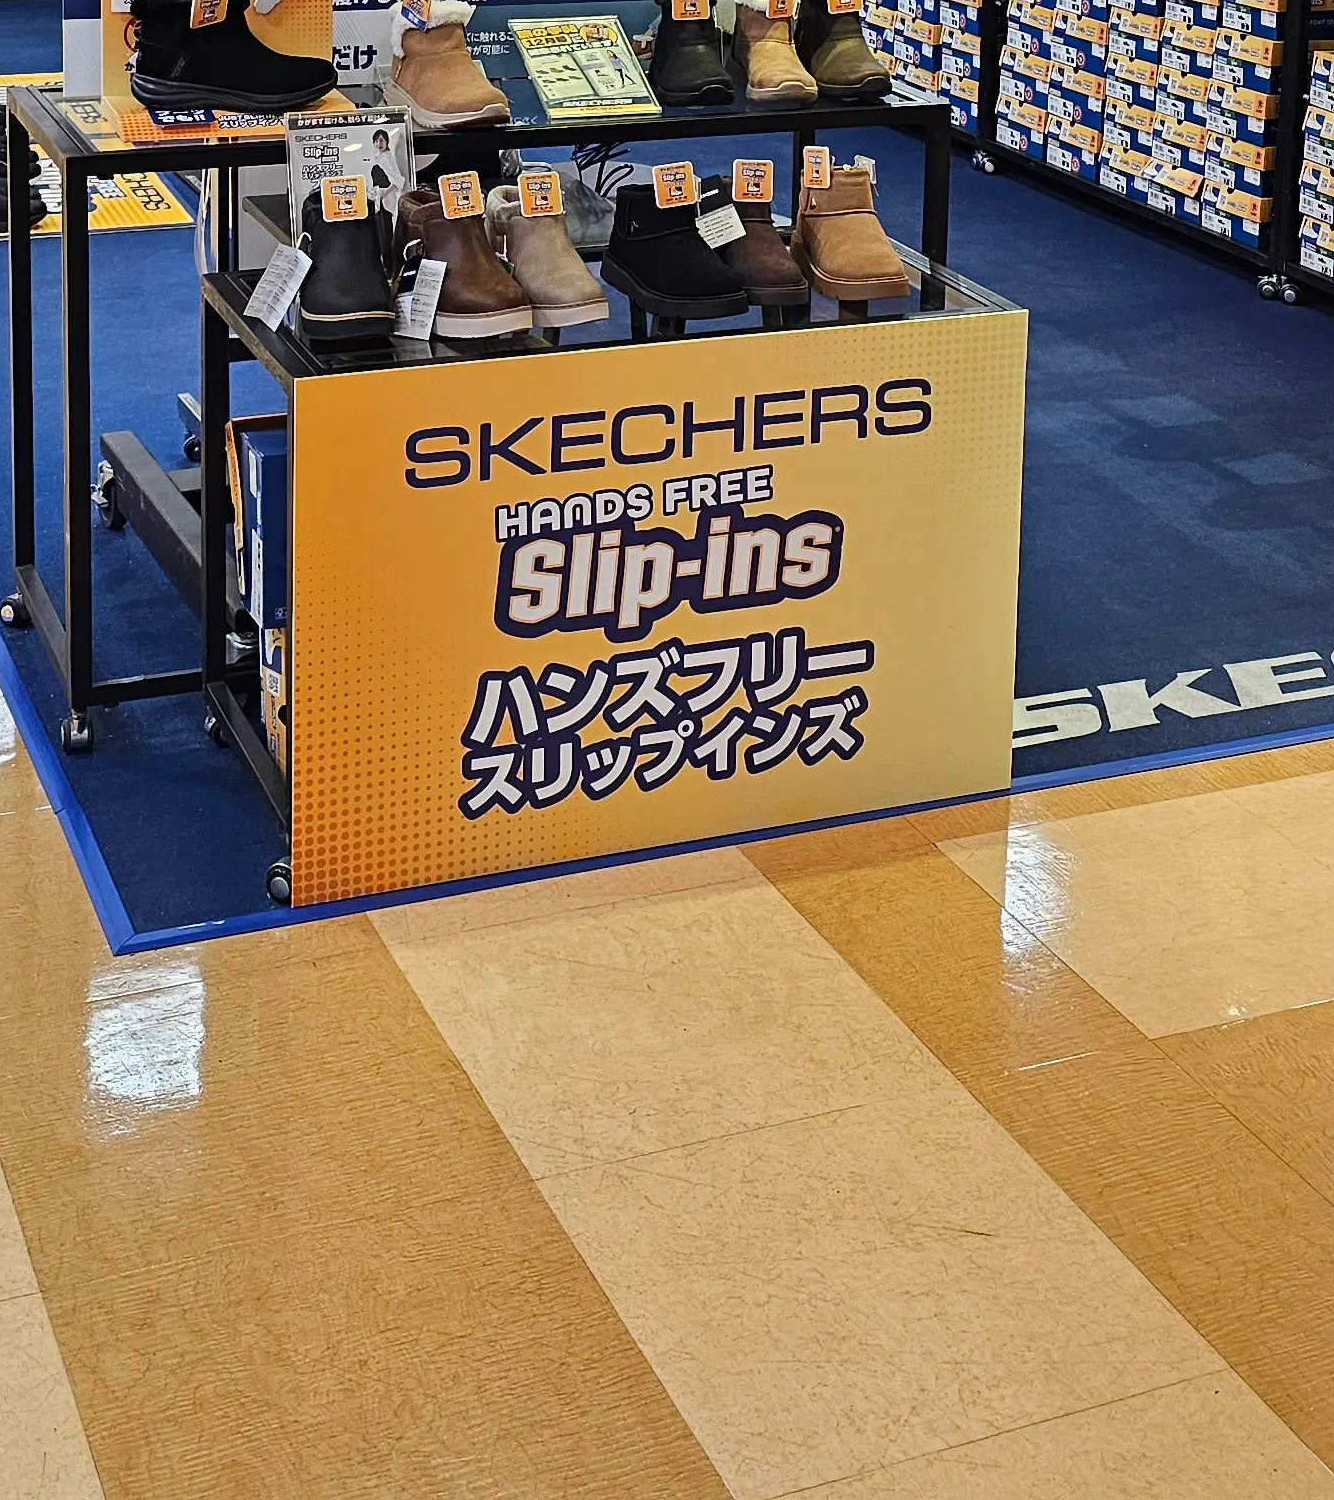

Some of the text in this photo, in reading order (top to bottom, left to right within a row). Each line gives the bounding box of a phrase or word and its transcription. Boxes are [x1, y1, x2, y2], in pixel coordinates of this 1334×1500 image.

[404, 377, 933, 490] SKECHERS
[497, 465, 773, 542] HANDS FREE
[508, 515, 837, 631] Slip-ins
[468, 634, 869, 747] ハンズフリー
[466, 695, 861, 813] スリップインズ
